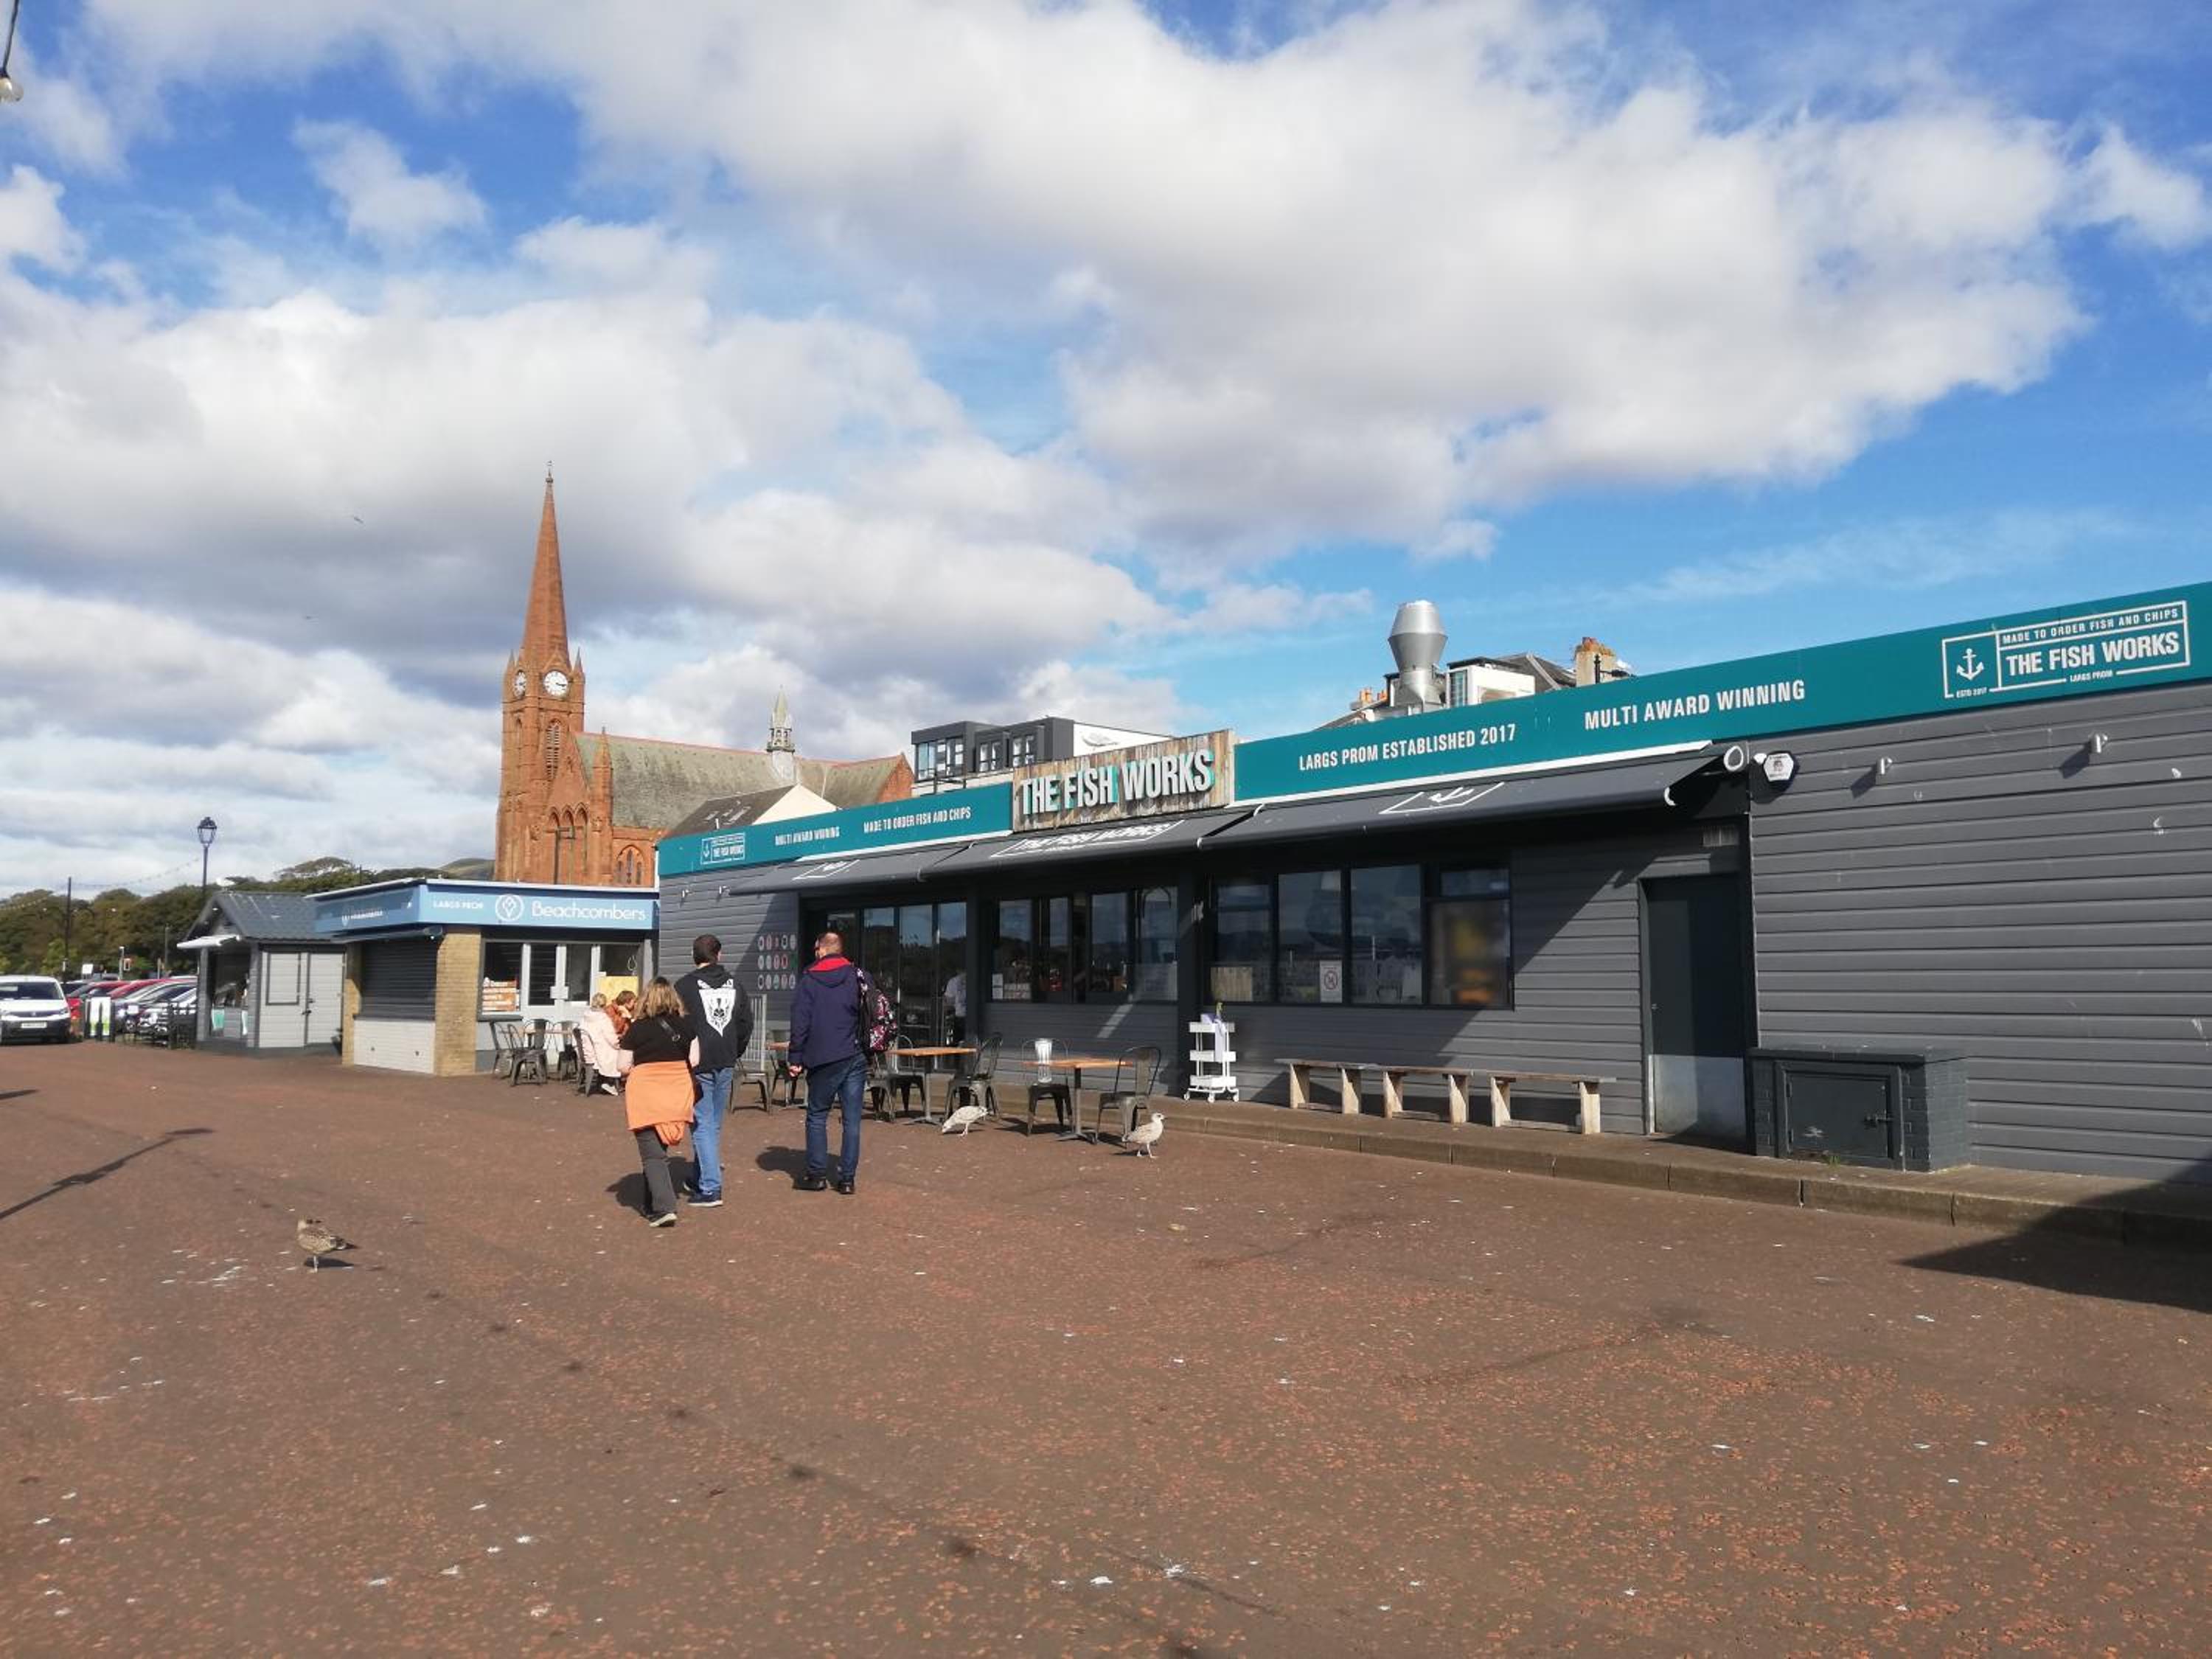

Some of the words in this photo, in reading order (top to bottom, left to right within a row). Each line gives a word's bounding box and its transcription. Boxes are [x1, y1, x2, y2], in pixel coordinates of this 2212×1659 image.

[2002, 633, 2031, 644] MADE
[2035, 630, 2046, 640] TO
[2051, 623, 2086, 637] ORDER
[2090, 619, 2114, 632] FISH
[2118, 614, 2140, 627] AND
[2144, 608, 2178, 623] CHIPS
[2006, 652, 2043, 676] THE
[2049, 641, 2095, 670] FISH
[2102, 632, 2180, 663] WORKS
[1585, 703, 1637, 730] MULTI
[1644, 694, 1710, 722] AWARD
[1717, 680, 1805, 712] WINNING
[1299, 751, 1338, 771] LARGS
[1342, 743, 1378, 765] PROM
[1382, 733, 1475, 759] ESTABLISHED
[1481, 723, 1517, 745] 2017
[1023, 776, 1062, 815] THE
[1064, 765, 1119, 809] FISH
[1121, 748, 1215, 801] WORKS
[863, 820, 882, 834] MADE
[883, 818, 891, 830] TO
[893, 814, 914, 830] ORDER
[916, 812, 931, 825] FISH
[933, 810, 947, 823] AND
[949, 806, 971, 821] CHIPS
[532, 900, 646, 920] Beachcombers
